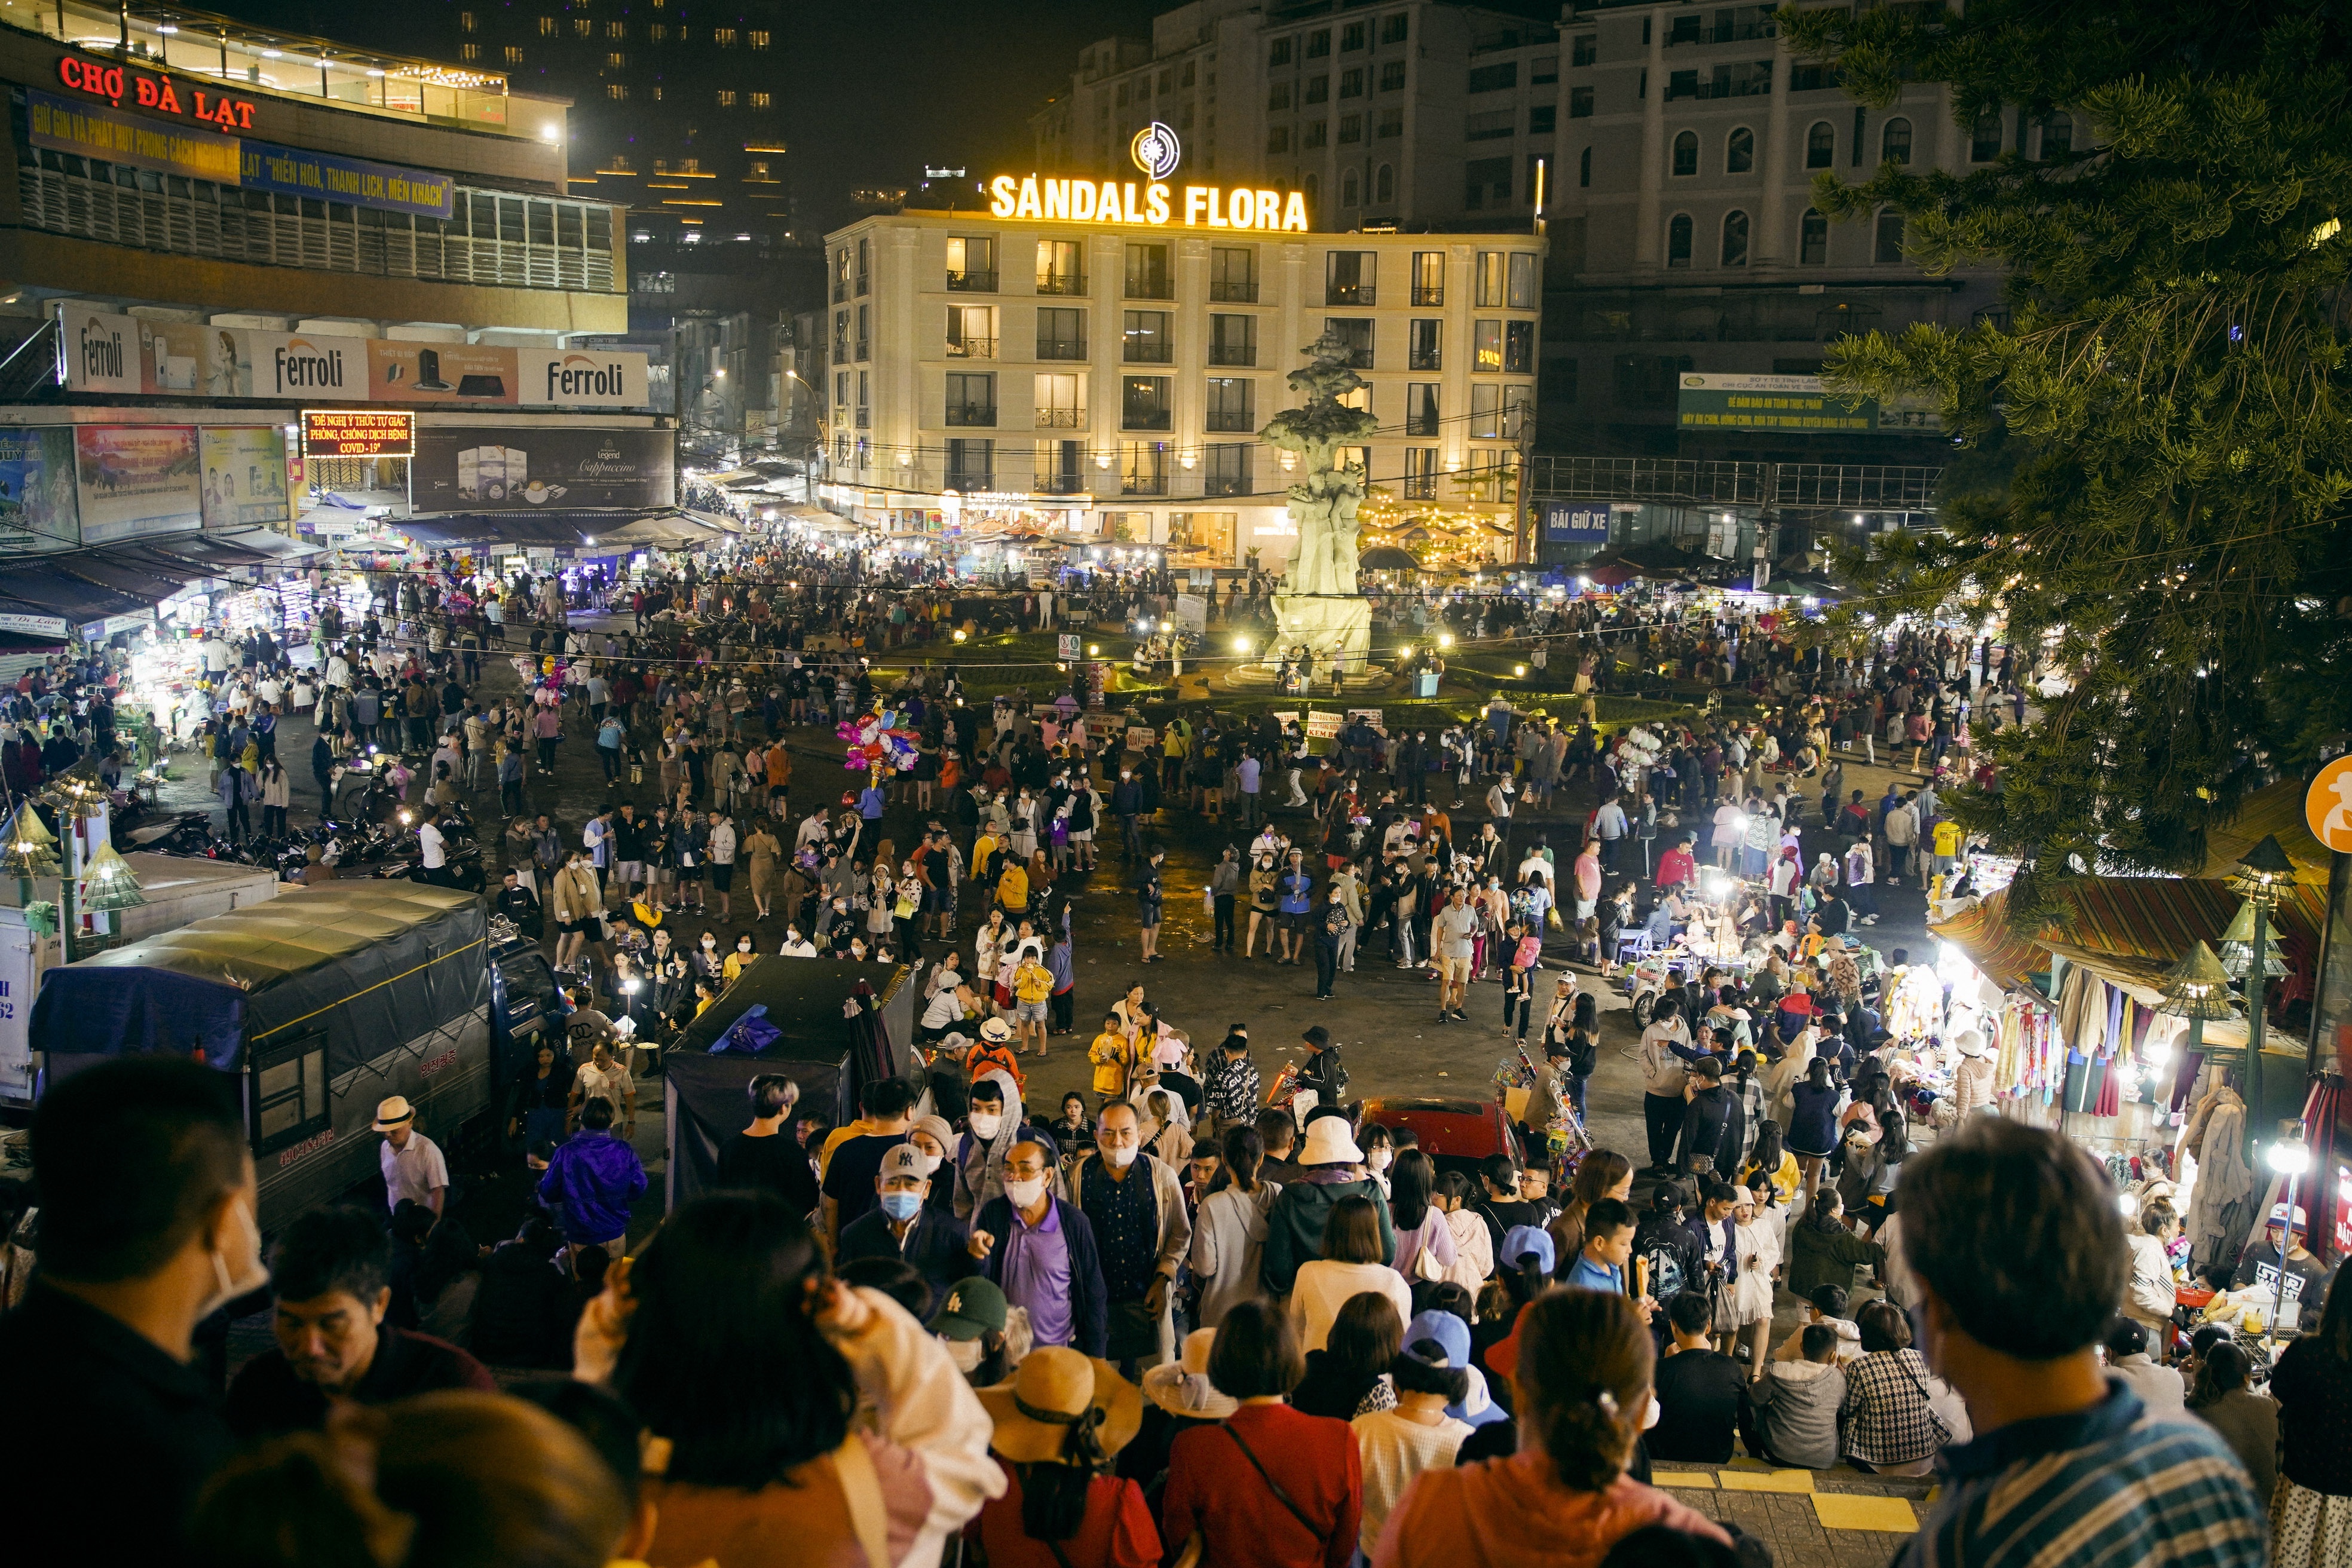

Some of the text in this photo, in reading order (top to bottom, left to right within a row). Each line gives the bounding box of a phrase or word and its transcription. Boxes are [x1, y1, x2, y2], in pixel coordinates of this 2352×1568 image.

[61, 57, 255, 133] CHỢ ĐÀ LẠT
[72, 109, 87, 143] VÀ
[115, 124, 134, 152] HUY
[136, 128, 167, 160] PHONG
[170, 133, 194, 165] CÁCH
[241, 152, 260, 182] LẠT
[300, 160, 323, 192] HOÀ,
[326, 168, 359, 195] THANH
[362, 174, 385, 201] LỊCH,
[389, 173, 409, 202] MẾN
[991, 175, 1308, 232] SANDALS FLORA
[327, 415, 347, 428] NGHỊ
[348, 414, 354, 426] Ý
[355, 414, 376, 426] THỨC
[377, 415, 388, 428] TỰ
[388, 414, 406, 426] GIÁC
[310, 427, 408, 442] PHÒNG, CHỐNG DỊCH BỆNH
[340, 443, 365, 453] COVID
[598, 451, 620, 460] Legend
[580, 459, 635, 476] Cappuccino
[1551, 509, 1606, 529] BÃI GIỮ XE
[425, 535, 501, 546] mobifone
[899, 1152, 913, 1166] NY
